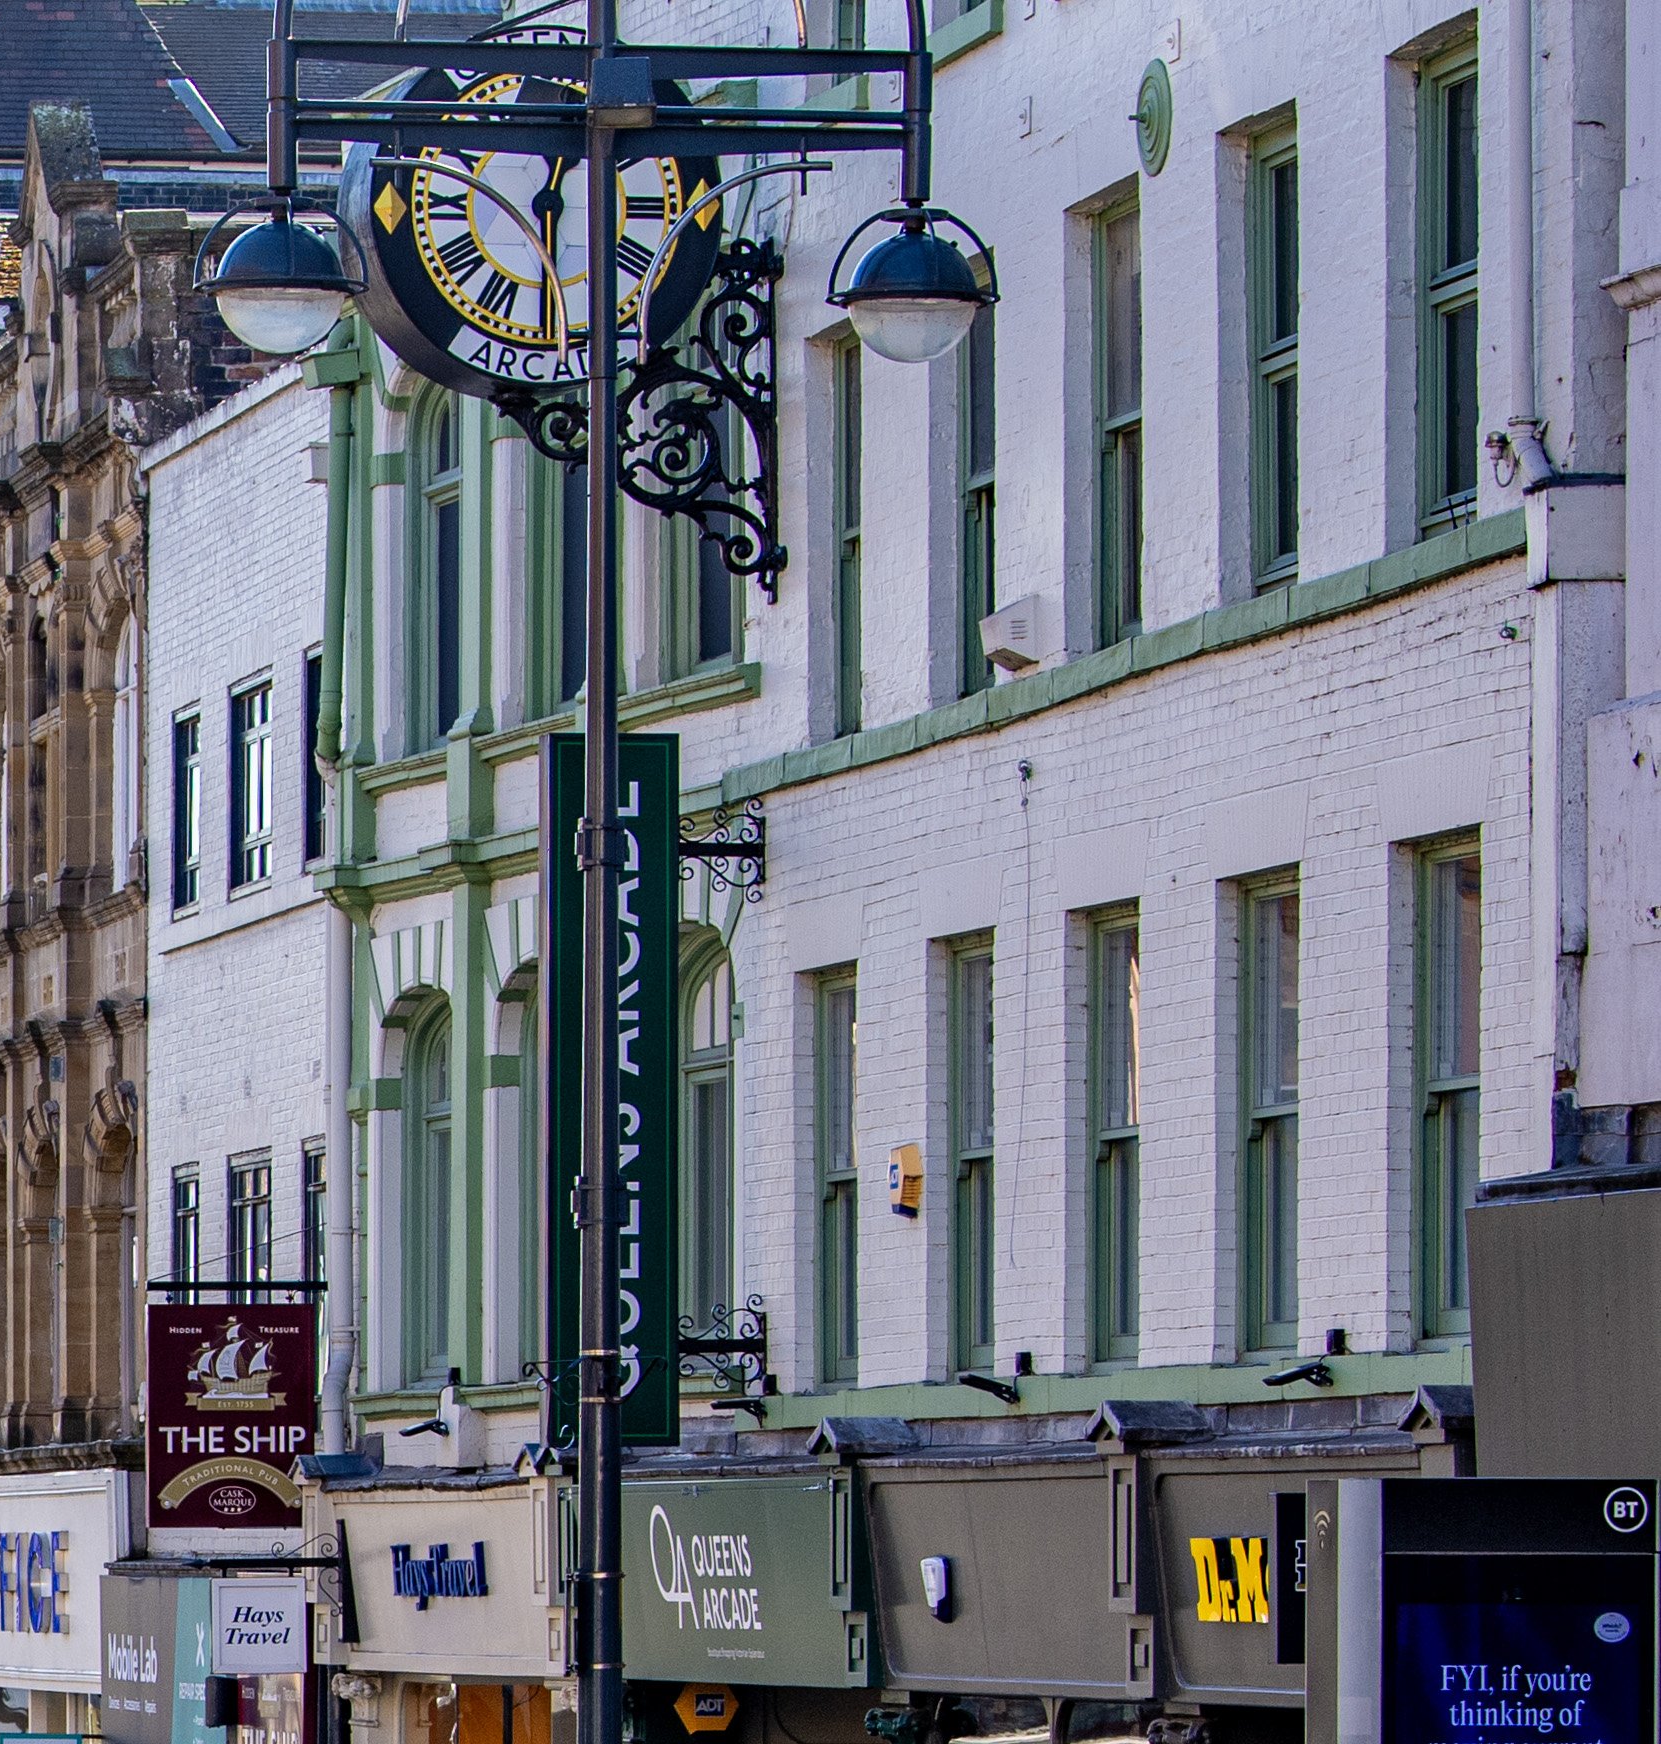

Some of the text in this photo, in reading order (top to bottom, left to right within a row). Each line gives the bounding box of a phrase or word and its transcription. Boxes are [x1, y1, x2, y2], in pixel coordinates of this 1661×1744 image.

[169, 1326, 202, 1334] HIDDEN
[259, 1325, 299, 1334] TREASURE
[158, 1426, 306, 1454] THE SHIP
[182, 1464, 278, 1487] TRADITIONAL PUB
[213, 1498, 253, 1507] MARQUE
[220, 1489, 244, 1498] CASK
[1613, 1502, 1638, 1519] BT
[691, 1534, 753, 1578] QUEENS
[390, 1540, 490, 1612] Hays Travel
[1189, 1537, 1270, 1623] Dr.M
[232, 1606, 285, 1625] Hays
[703, 1588, 763, 1631] ARCADE
[225, 1627, 291, 1645] Travel
[108, 1633, 158, 1684] Mobile Lab
[1440, 1664, 1592, 1697] FYI, if you're
[696, 1697, 725, 1714] ADT
[1449, 1700, 1585, 1733] thinking of
